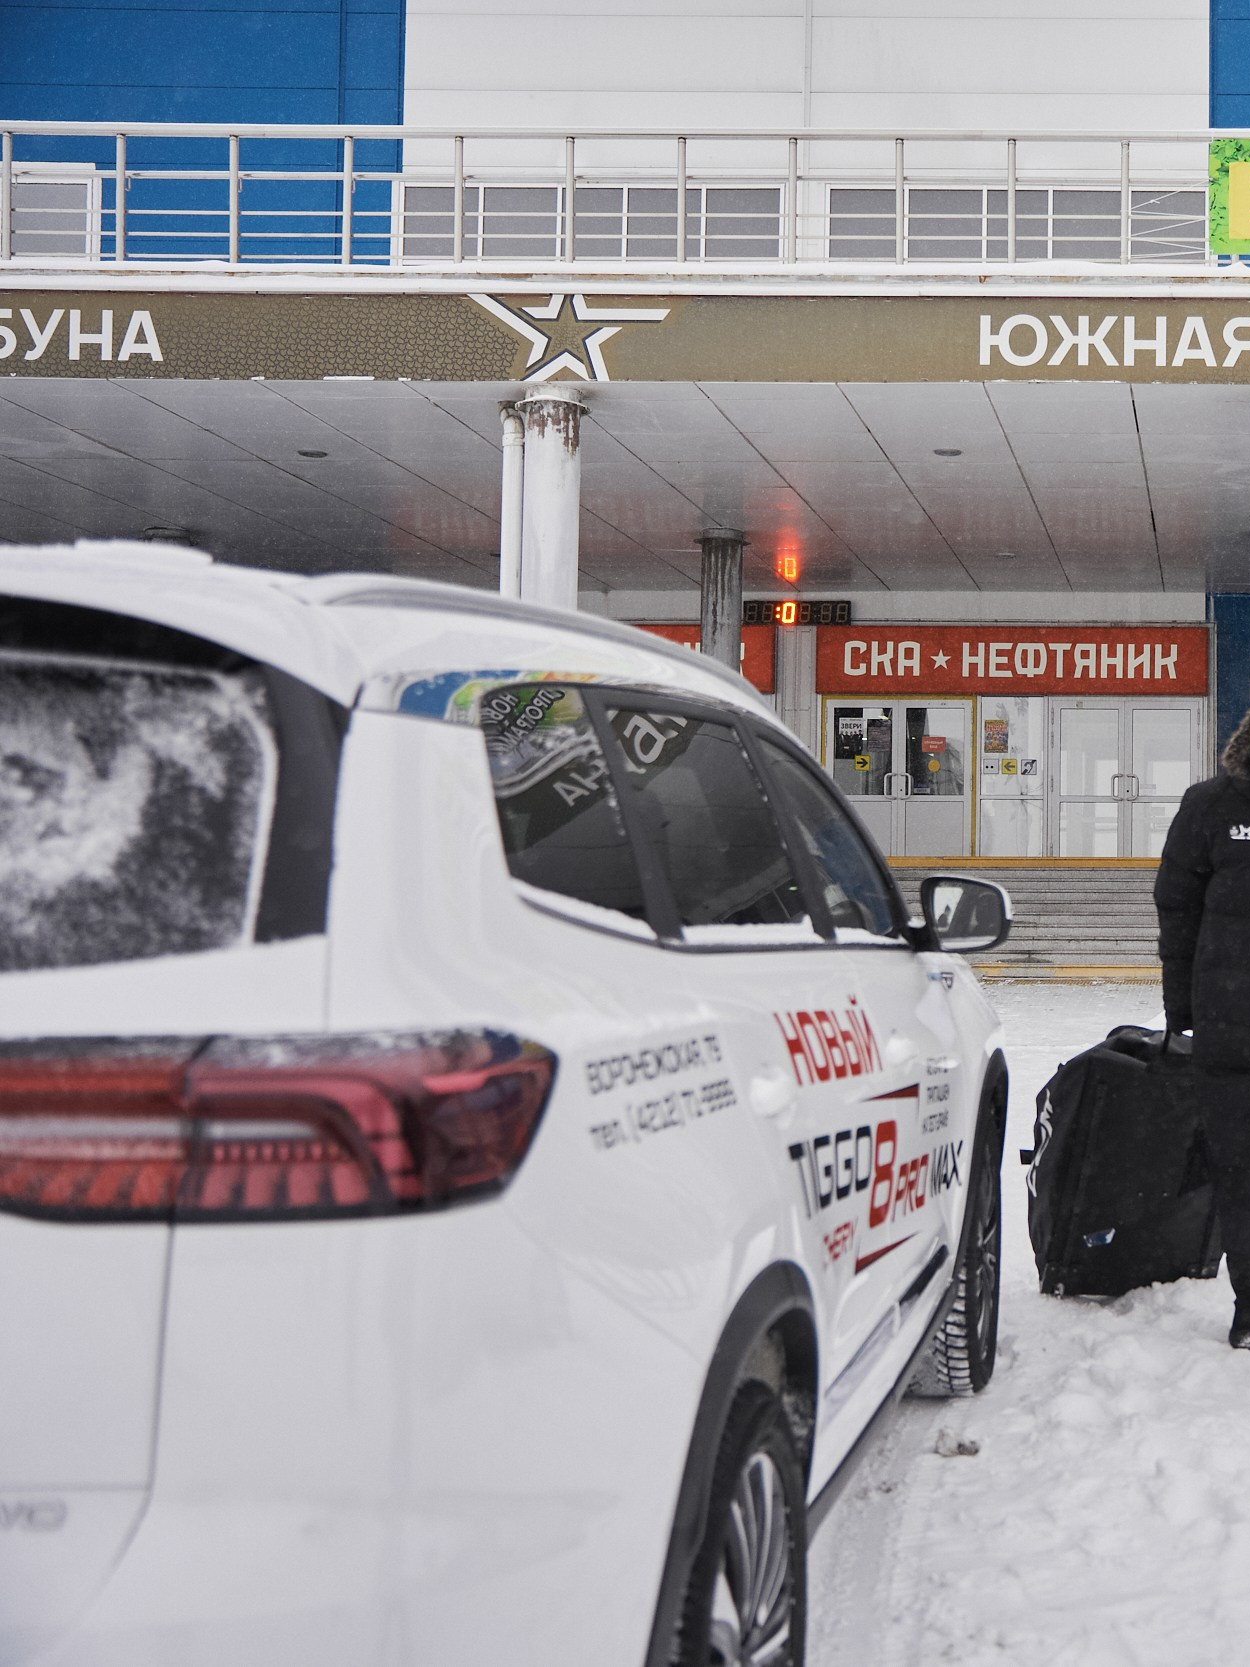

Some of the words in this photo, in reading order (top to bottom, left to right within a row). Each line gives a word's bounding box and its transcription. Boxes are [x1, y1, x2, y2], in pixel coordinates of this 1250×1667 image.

[843, 640, 920, 676] СКА
[962, 641, 1178, 680] НЕФТЯНИК
[774, 995, 883, 1086] НОВЫЙ
[788, 1125, 873, 1219] TIGGO
[869, 1120, 897, 1229] 8
[892, 1153, 929, 1223] PRO
[931, 1139, 963, 1198] MAX
